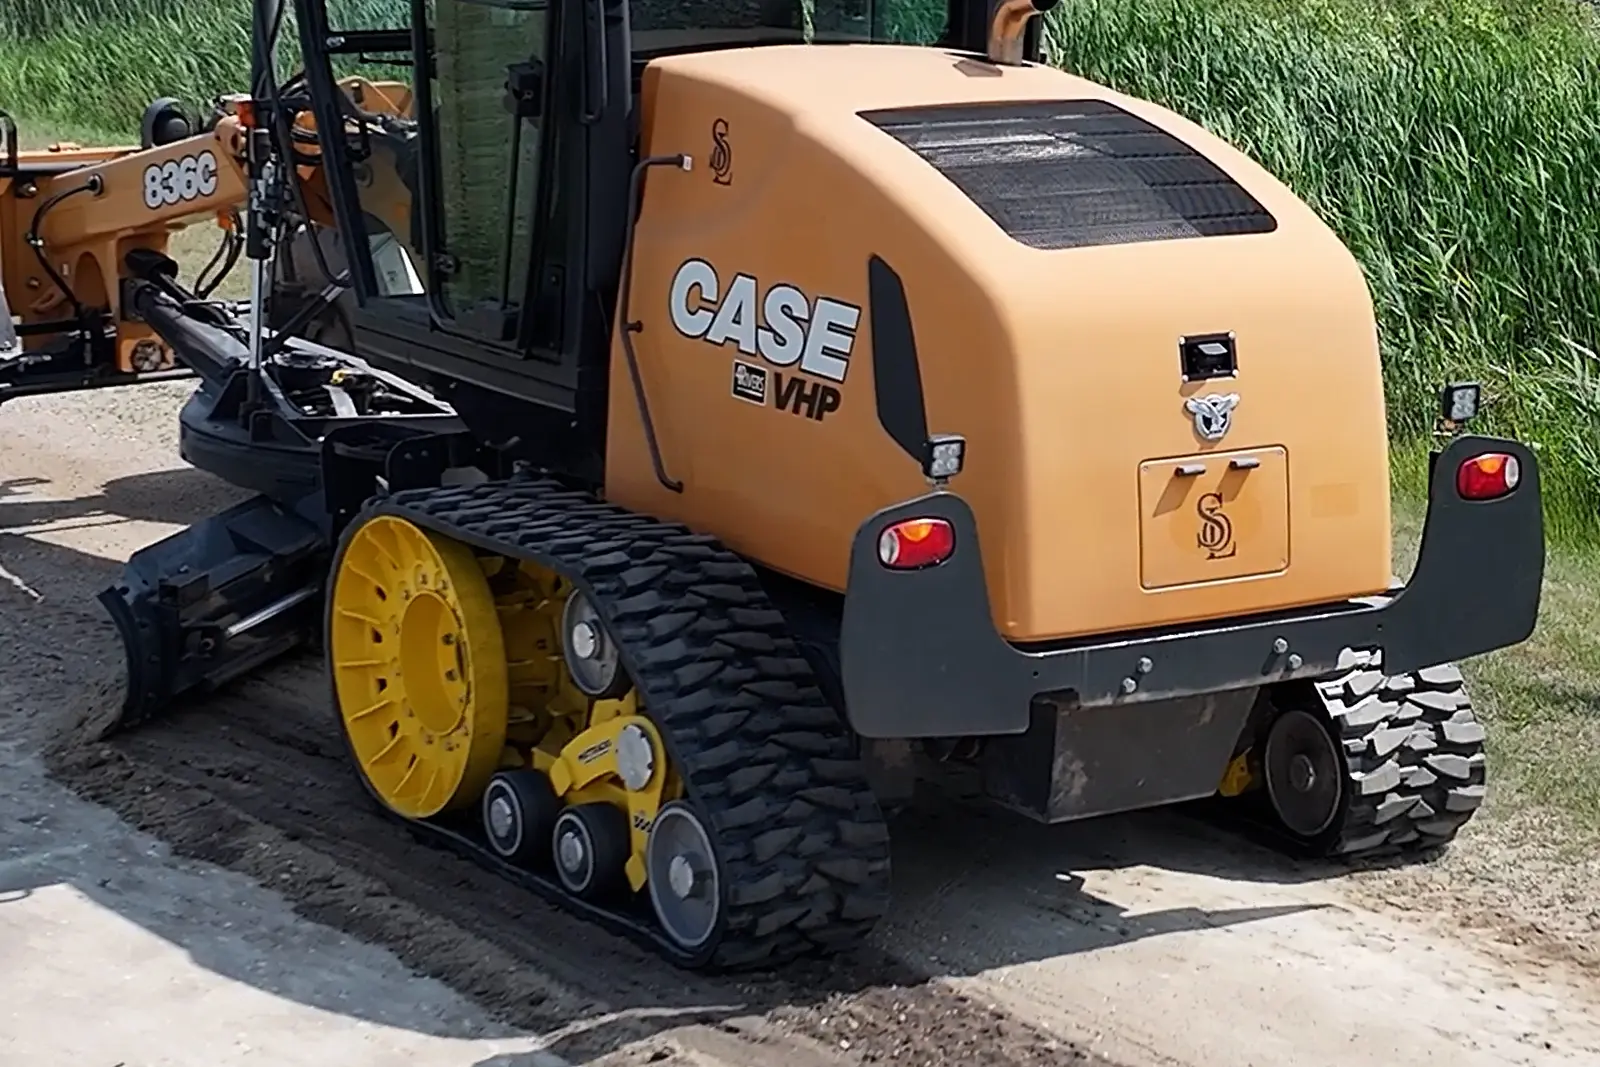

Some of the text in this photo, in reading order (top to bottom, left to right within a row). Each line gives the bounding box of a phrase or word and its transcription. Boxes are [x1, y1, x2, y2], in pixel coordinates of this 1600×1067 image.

[143, 150, 217, 209] 836C
[669, 257, 861, 384] CASE
[774, 372, 841, 421] VHP
